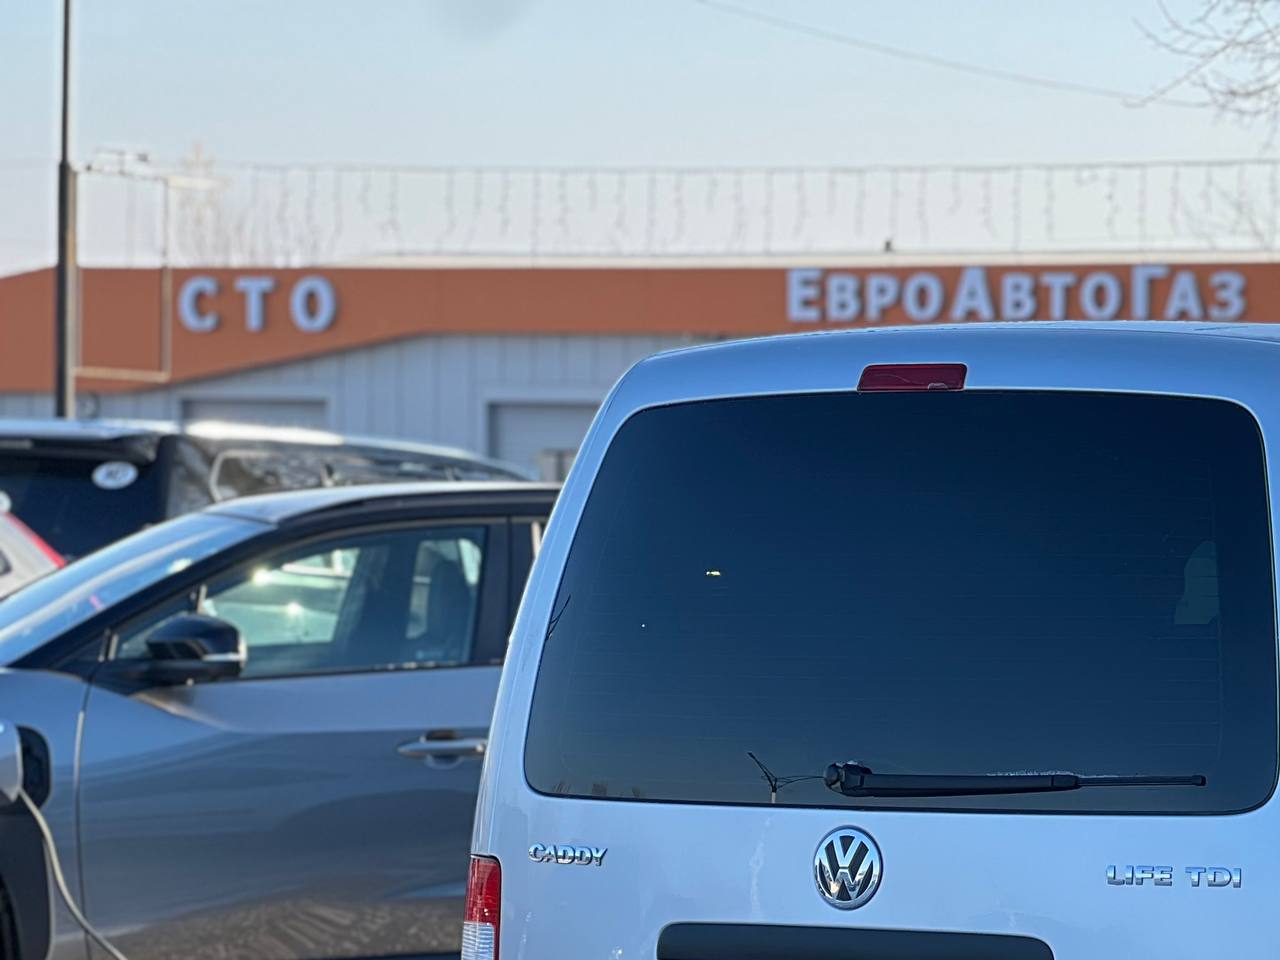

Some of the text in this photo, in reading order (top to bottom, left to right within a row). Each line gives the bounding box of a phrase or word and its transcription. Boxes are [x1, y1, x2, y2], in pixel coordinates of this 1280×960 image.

[178, 274, 338, 333] СТО
[527, 842, 609, 867] CADDY
[1105, 865, 1242, 888] LIFE TDI
